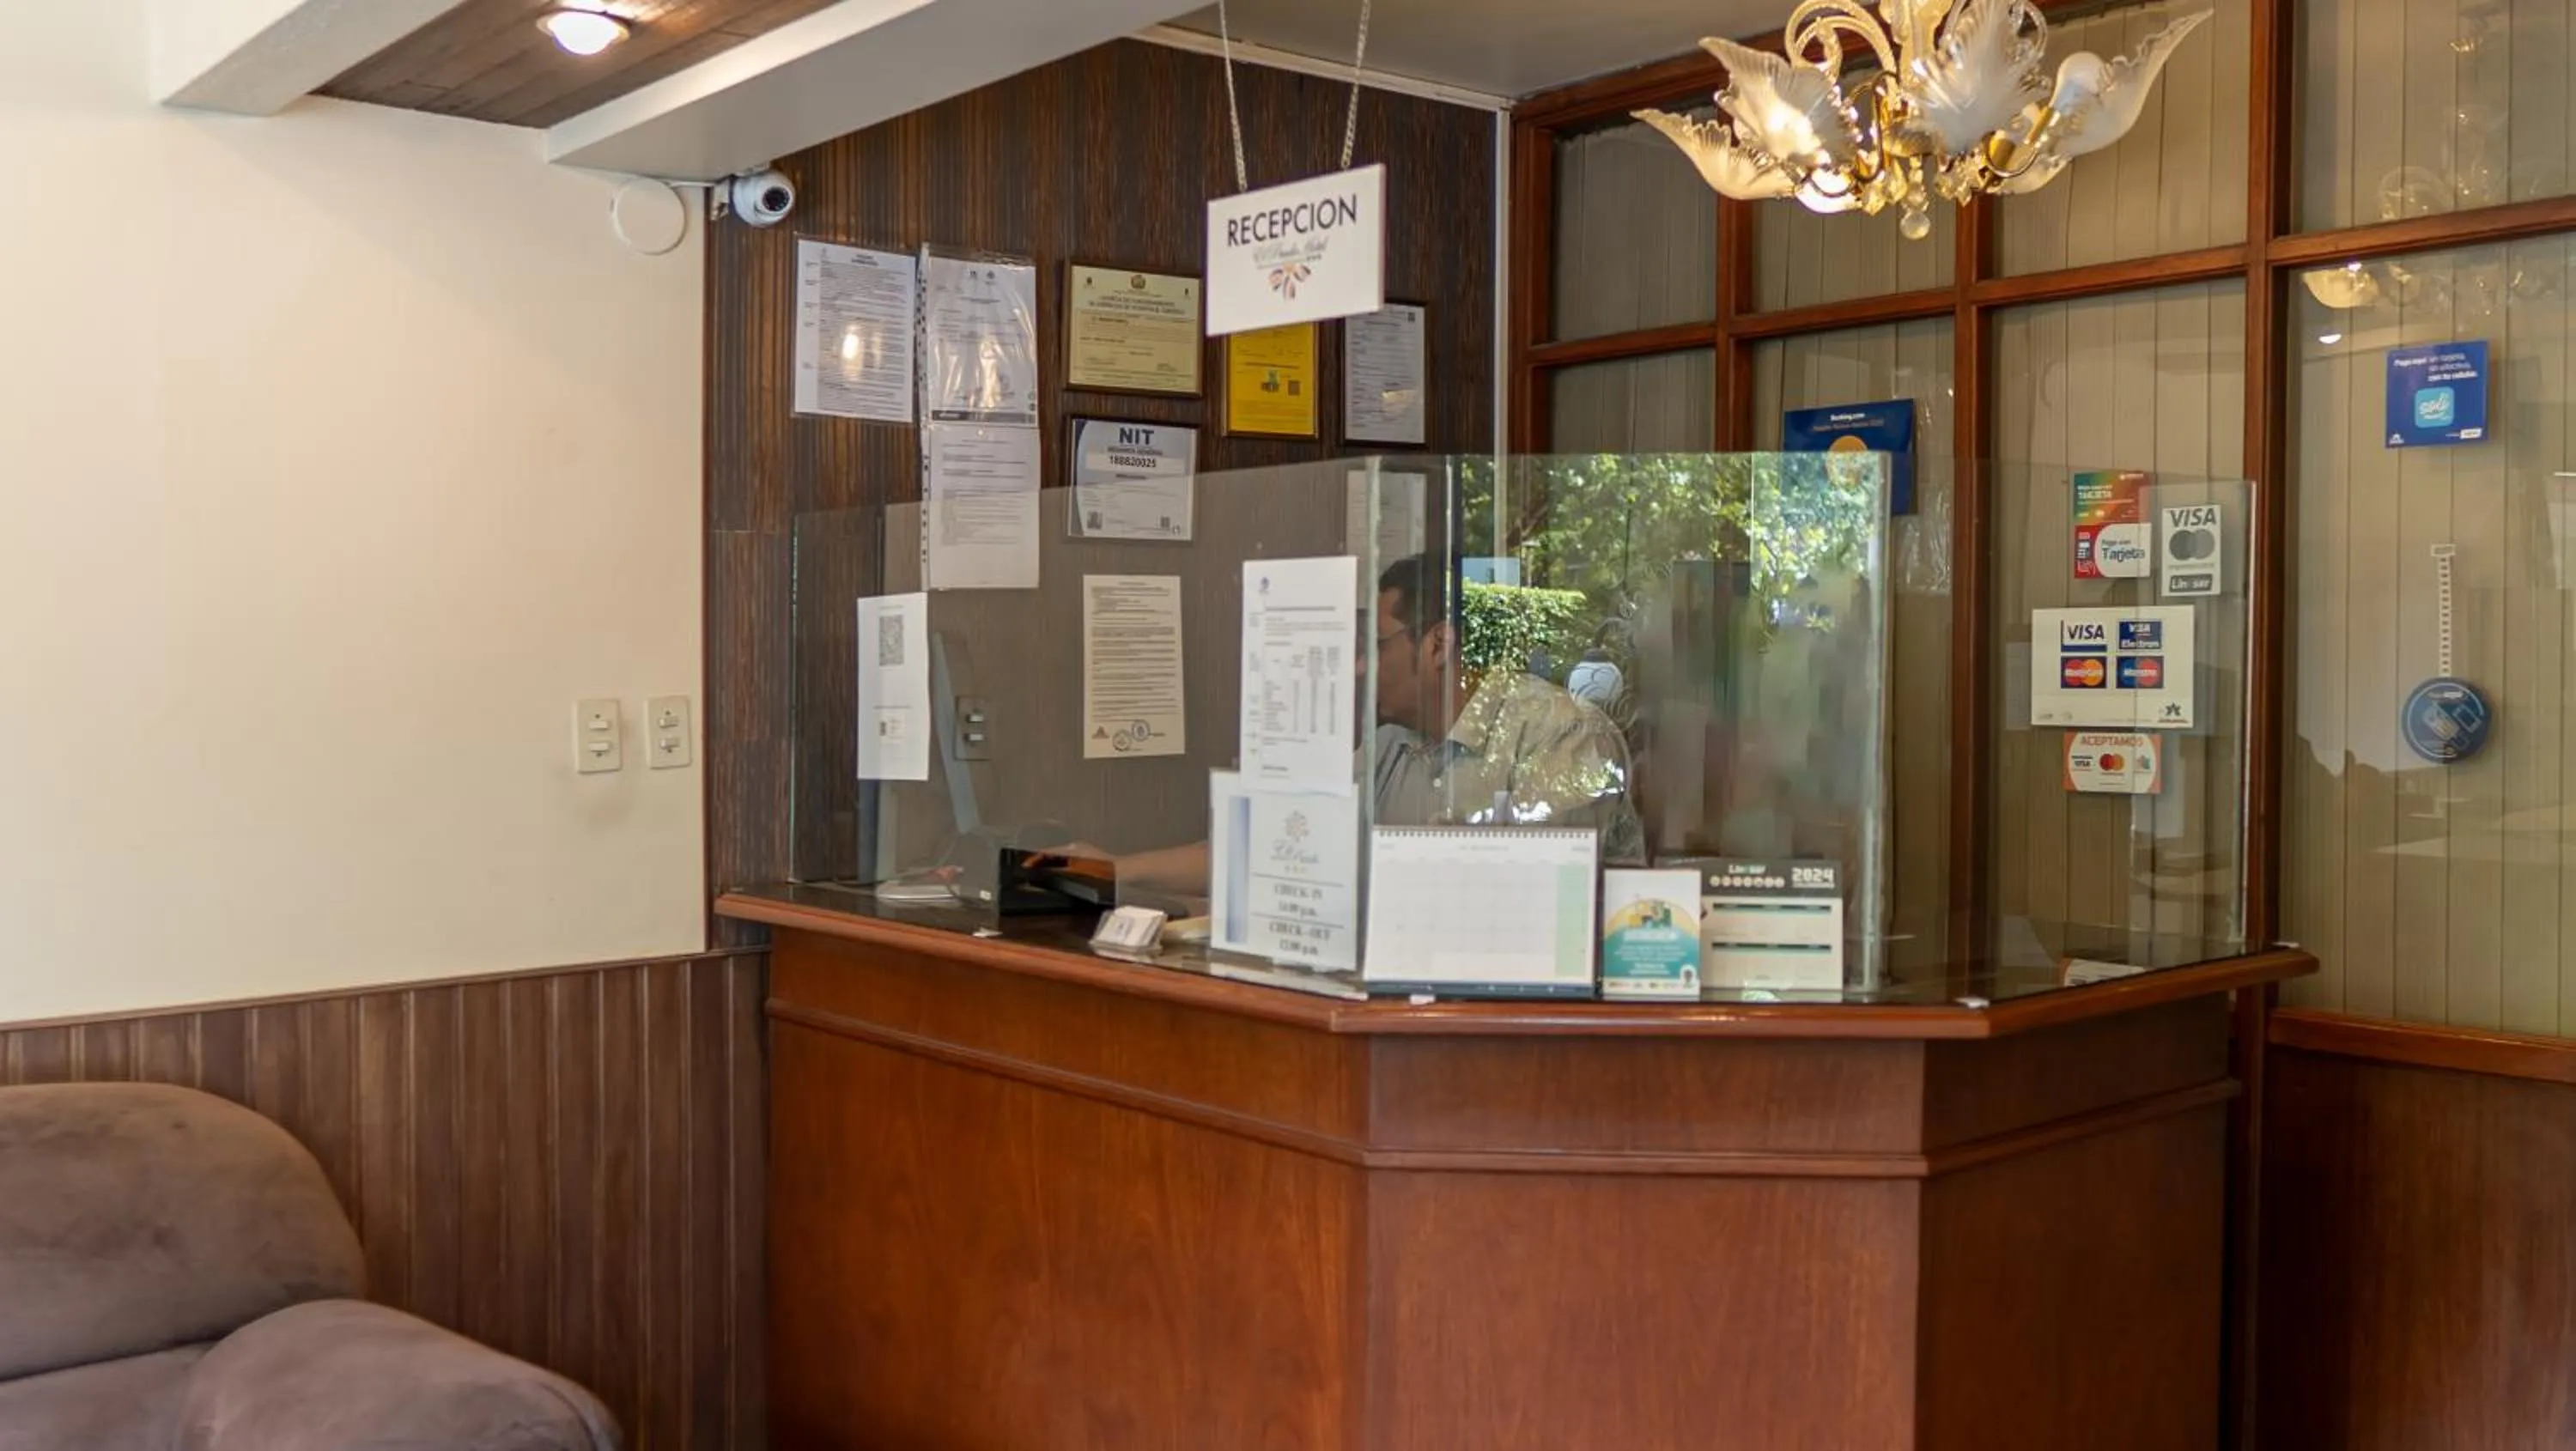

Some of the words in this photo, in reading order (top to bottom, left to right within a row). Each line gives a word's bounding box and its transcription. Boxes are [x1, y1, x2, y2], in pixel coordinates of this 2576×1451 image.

[1227, 193, 1357, 247] RECEPCION
[1119, 426, 1155, 445] NIT
[2170, 507, 2217, 527] VISA
[2101, 547, 2146, 562] Tarjeta
[2068, 624, 2105, 640] VISA
[2081, 736, 2143, 746] ACEPTAMOS
[1791, 867, 1835, 883] 2024
